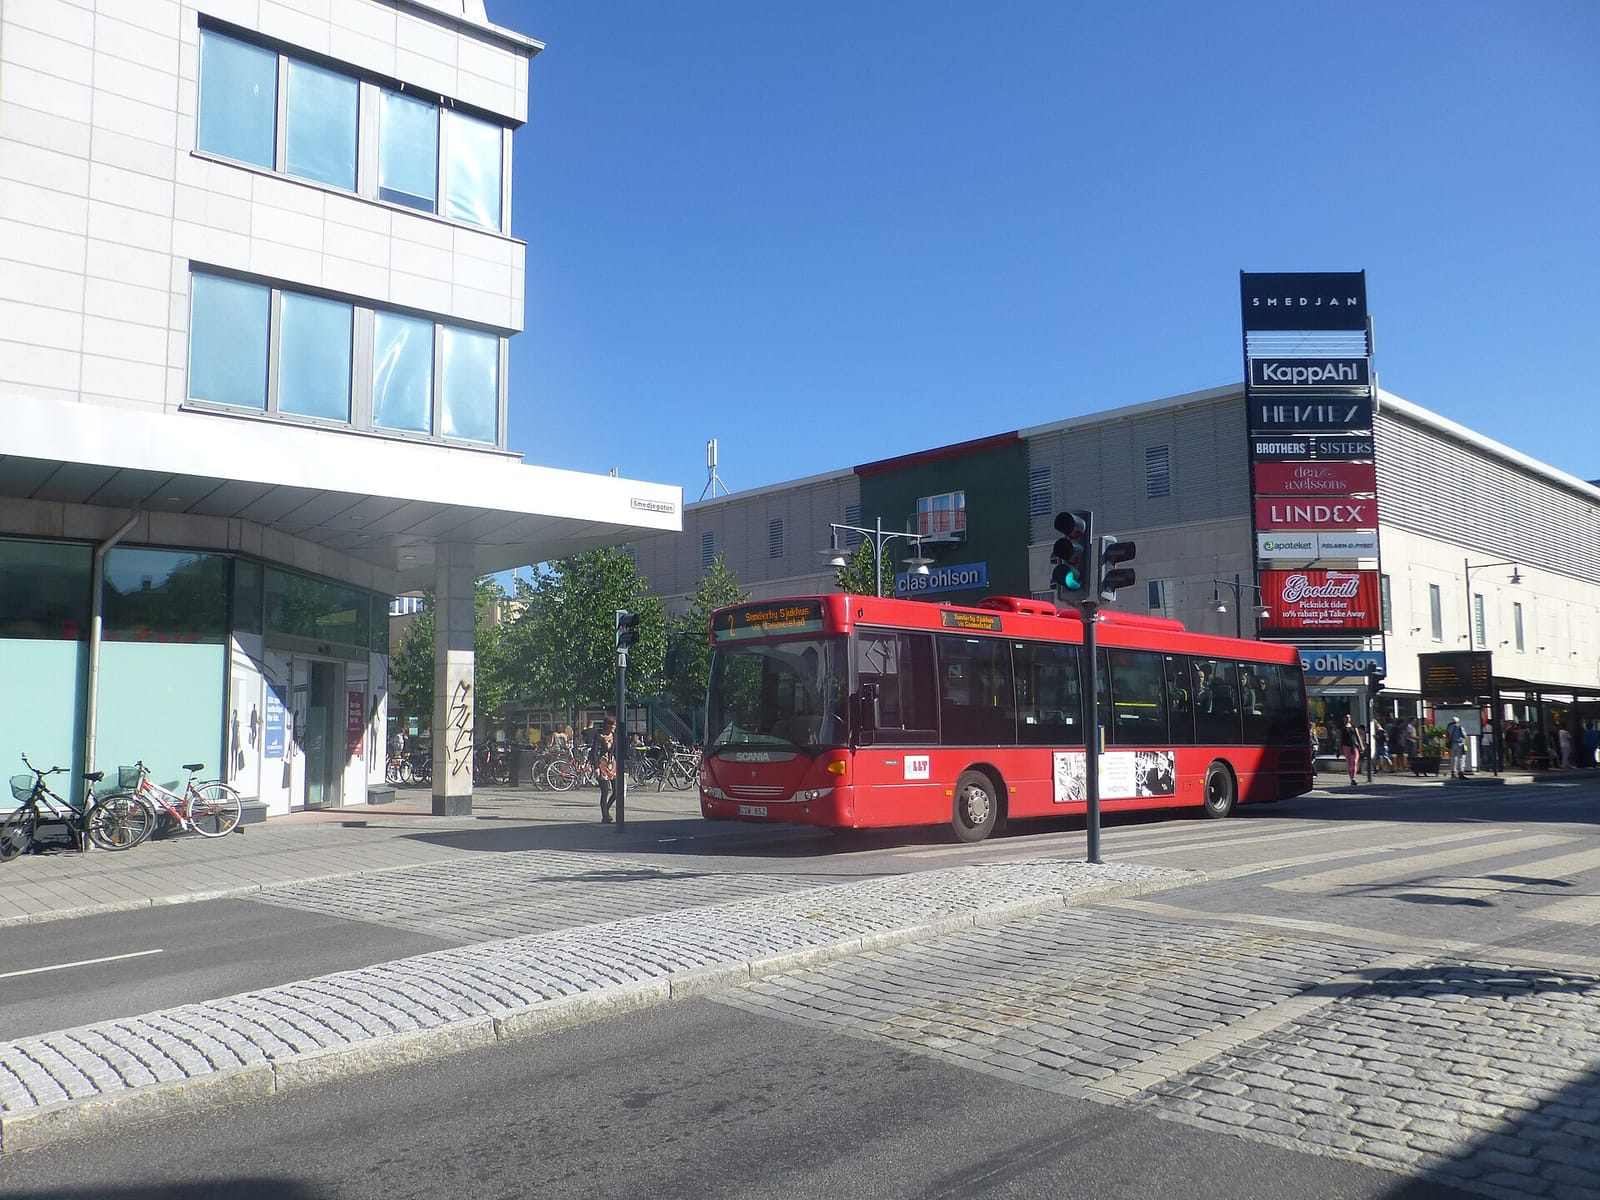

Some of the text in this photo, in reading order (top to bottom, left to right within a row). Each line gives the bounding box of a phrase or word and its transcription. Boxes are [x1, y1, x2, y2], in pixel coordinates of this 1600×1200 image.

[1252, 297, 1357, 306] SMEDJAN
[1262, 362, 1358, 384] KappAhl
[1256, 442, 1306, 454] BROTHERS
[1320, 442, 1372, 454] SISTERS
[1285, 478, 1346, 490] axelssons
[1271, 505, 1363, 522] LINDEX
[1274, 541, 1312, 551] apoteket
[898, 569, 978, 591] clas ohlson
[1282, 575, 1359, 603] Goodwill
[1320, 610, 1328, 619] på
[736, 752, 769, 761] SCANIA
